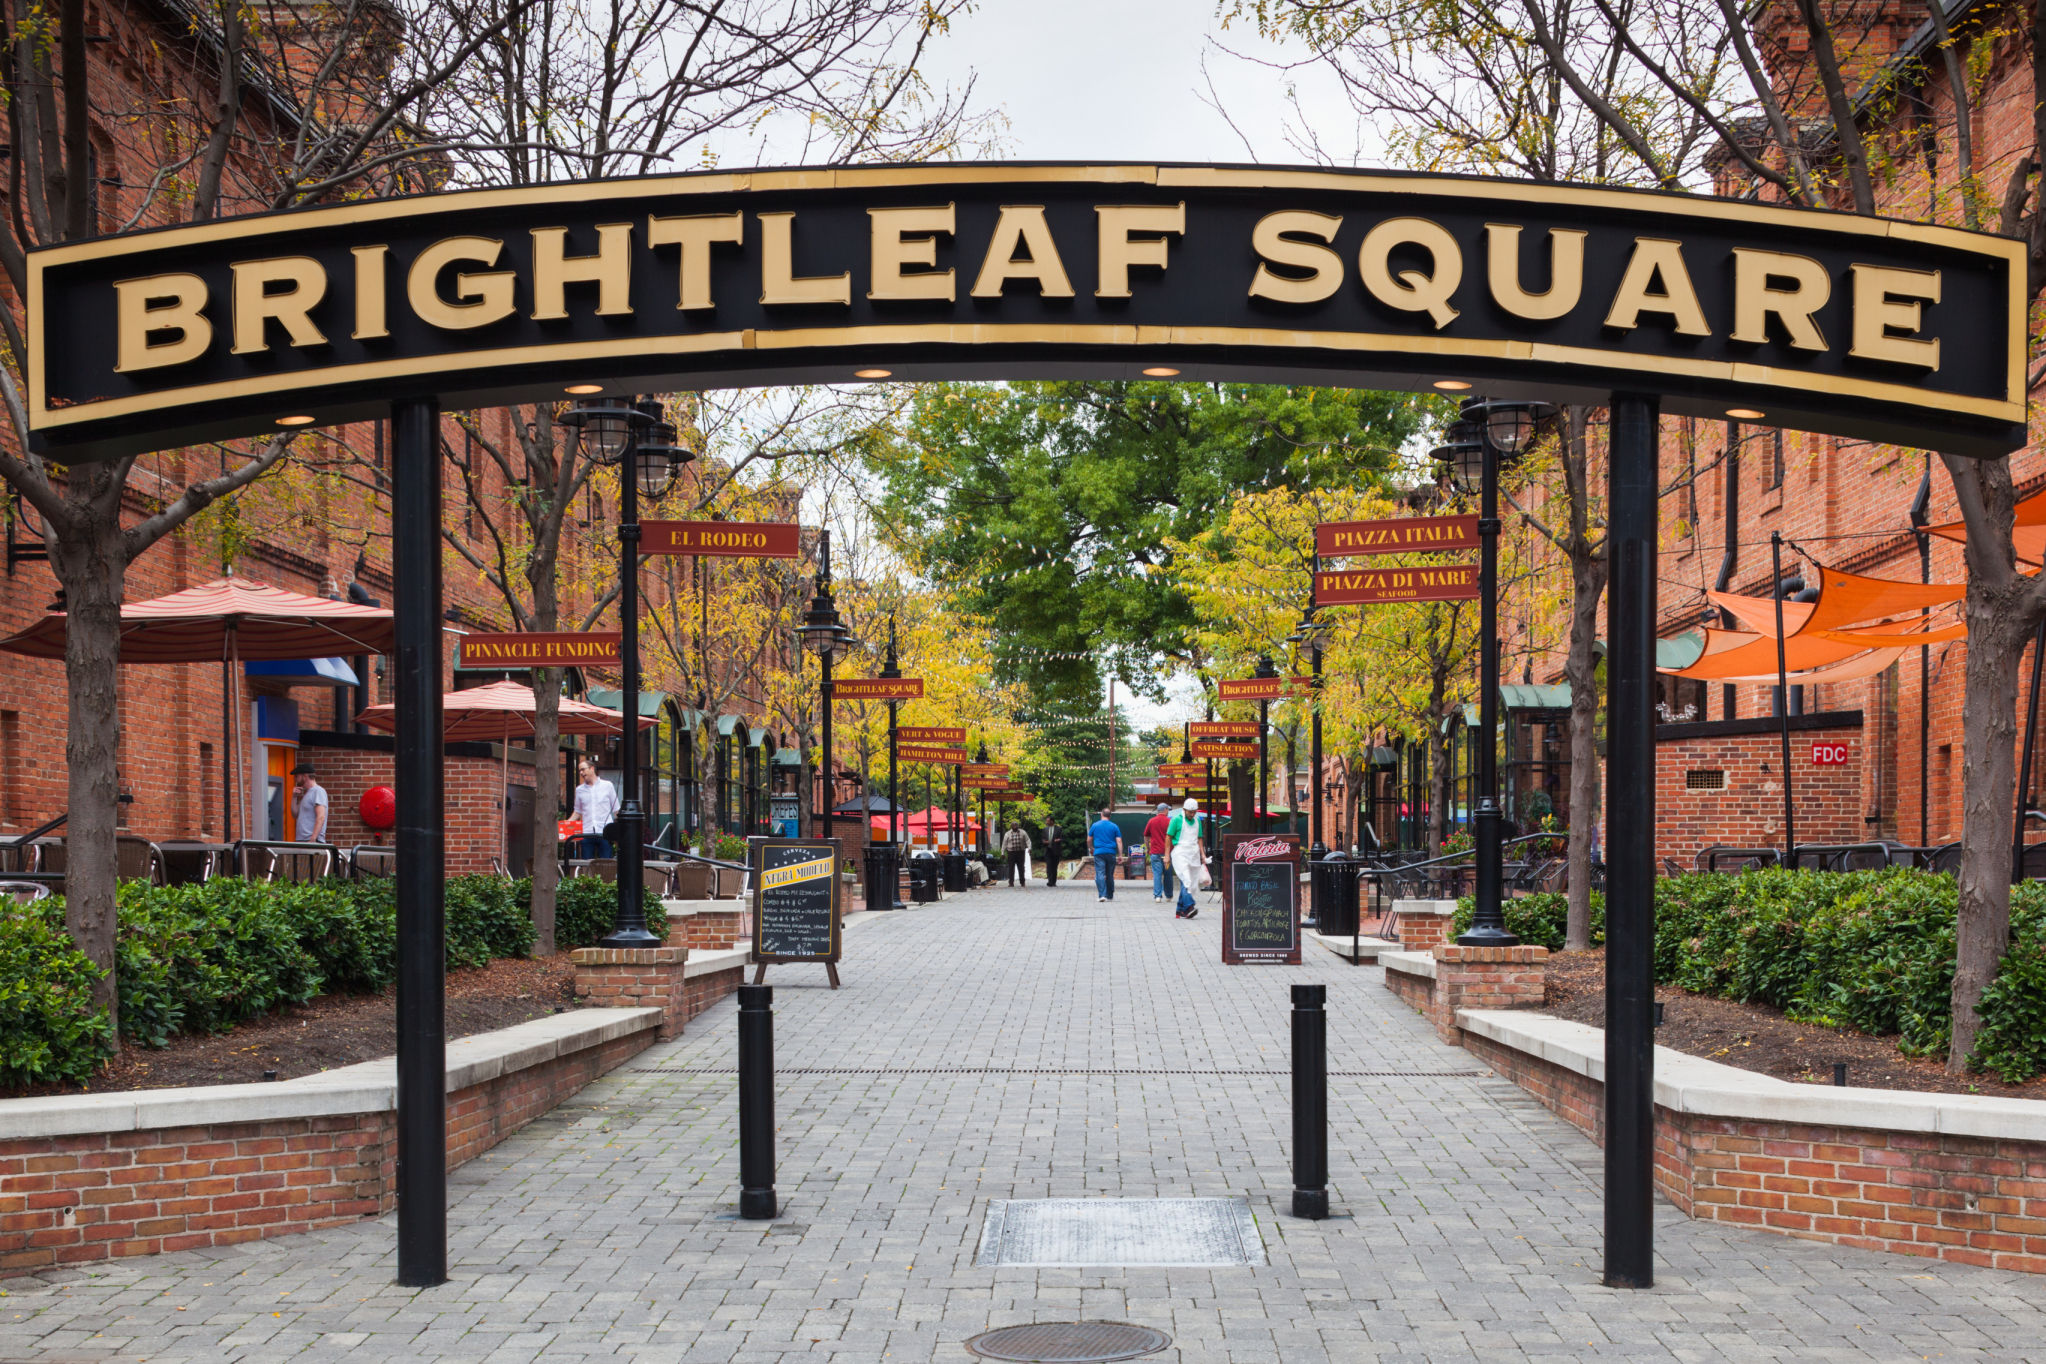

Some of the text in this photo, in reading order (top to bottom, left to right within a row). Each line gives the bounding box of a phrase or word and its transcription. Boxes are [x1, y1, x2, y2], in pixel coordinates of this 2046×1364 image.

[113, 203, 1943, 374] BRIGHTLEAF SQUARE
[671, 530, 768, 548] EL RODEO
[1334, 525, 1465, 547] PIAZZA ITALIA
[1322, 570, 1472, 591] PIAZZA DI MARE
[1376, 589, 1417, 599] SEAFOOD
[465, 641, 617, 658] PINNACLE FUNDING
[835, 683, 920, 695] BRIGHTLEAF SQUARE
[1223, 685, 1275, 695] BRIGHTLEAF
[901, 731, 961, 740] VERT & VOGUE
[1192, 725, 1259, 734] OFFBEAT MUSIC
[1197, 744, 1254, 753] SATISFACTION
[1813, 747, 1845, 762] FDC
[900, 750, 964, 761] HAMILTON HILL
[783, 848, 811, 856] CERVEZA
[1235, 835, 1291, 865] Victoria
[765, 862, 830, 886] NEGRA MODELO
